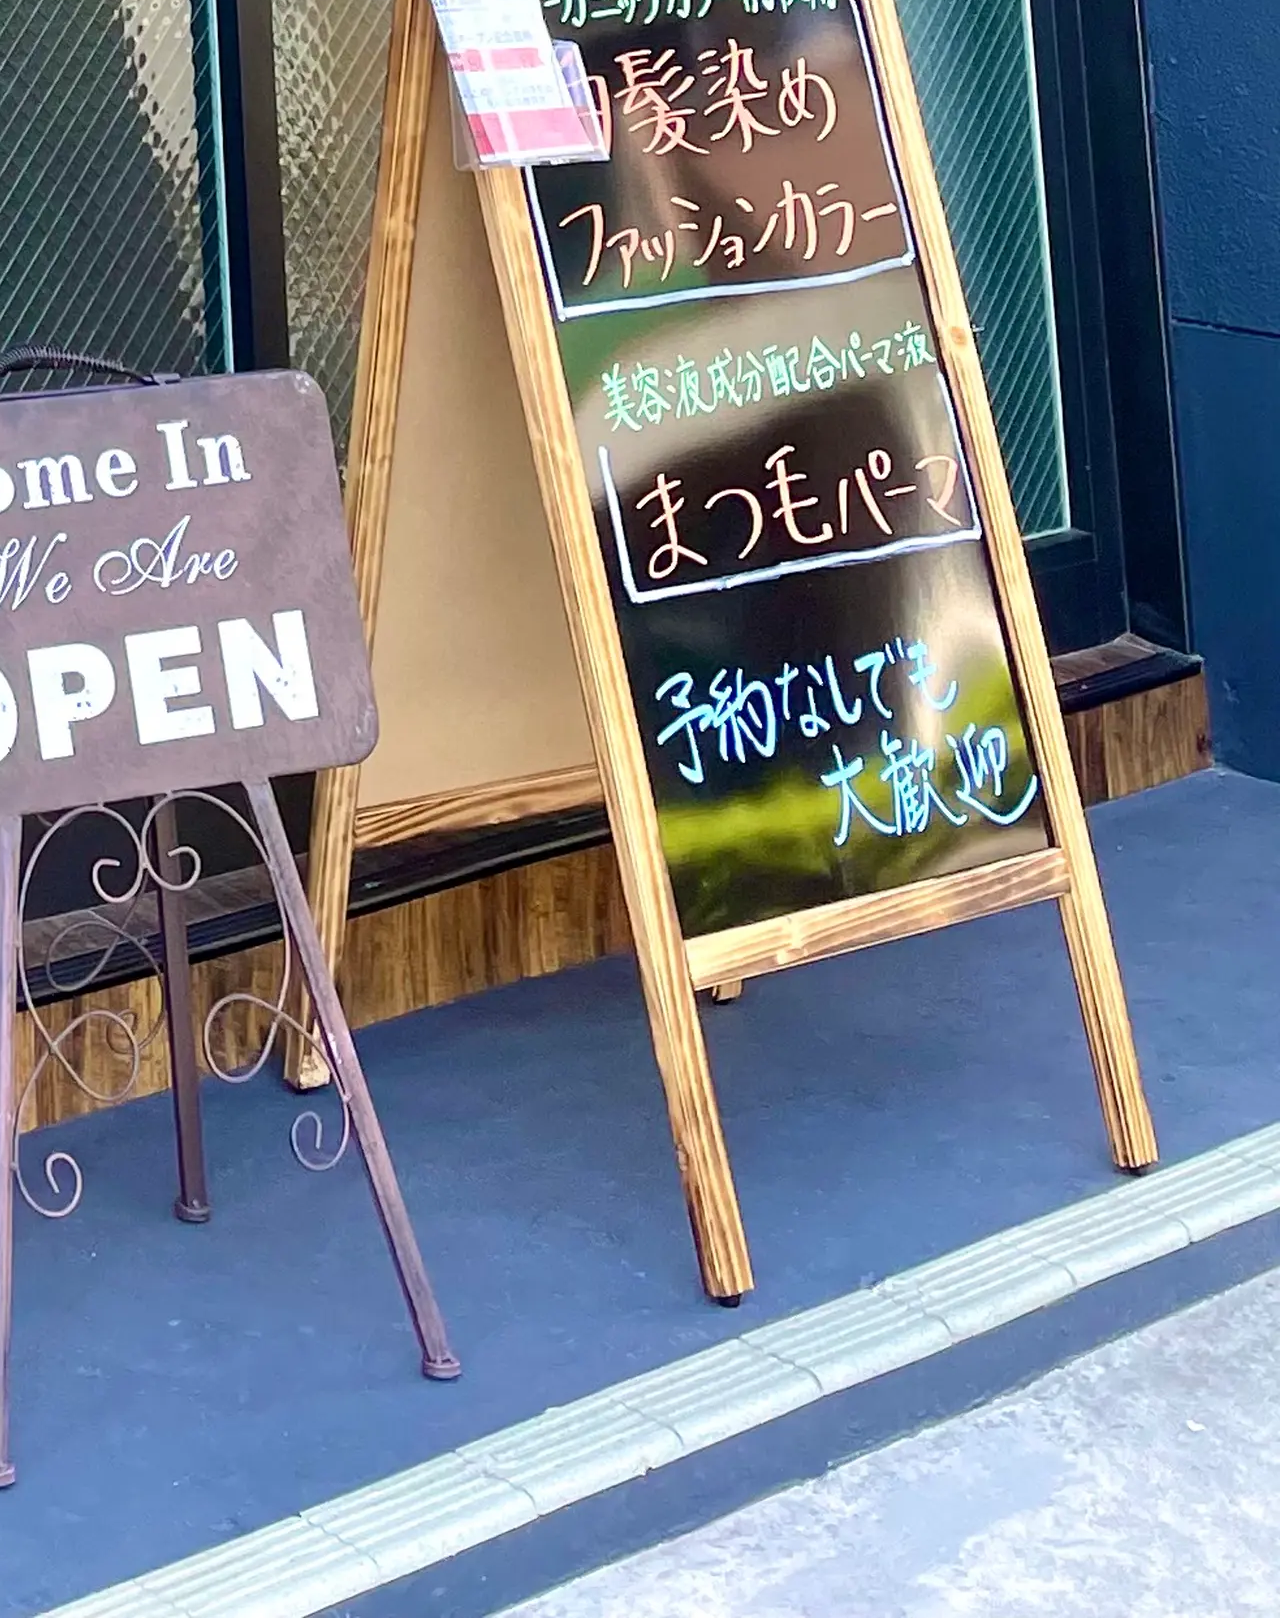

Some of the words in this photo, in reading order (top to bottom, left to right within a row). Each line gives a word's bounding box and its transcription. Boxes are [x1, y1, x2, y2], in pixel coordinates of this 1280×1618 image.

[559, 180, 898, 288] ファッションカラー
[601, 321, 937, 433] 美容液成分配合パーマ液
[156, 419, 251, 492] In
[93, 515, 238, 596] Are
[636, 445, 962, 579] まつ毛パーマ
[655, 636, 958, 784] 予約なしでも
[821, 722, 1039, 846] 大歓迎
